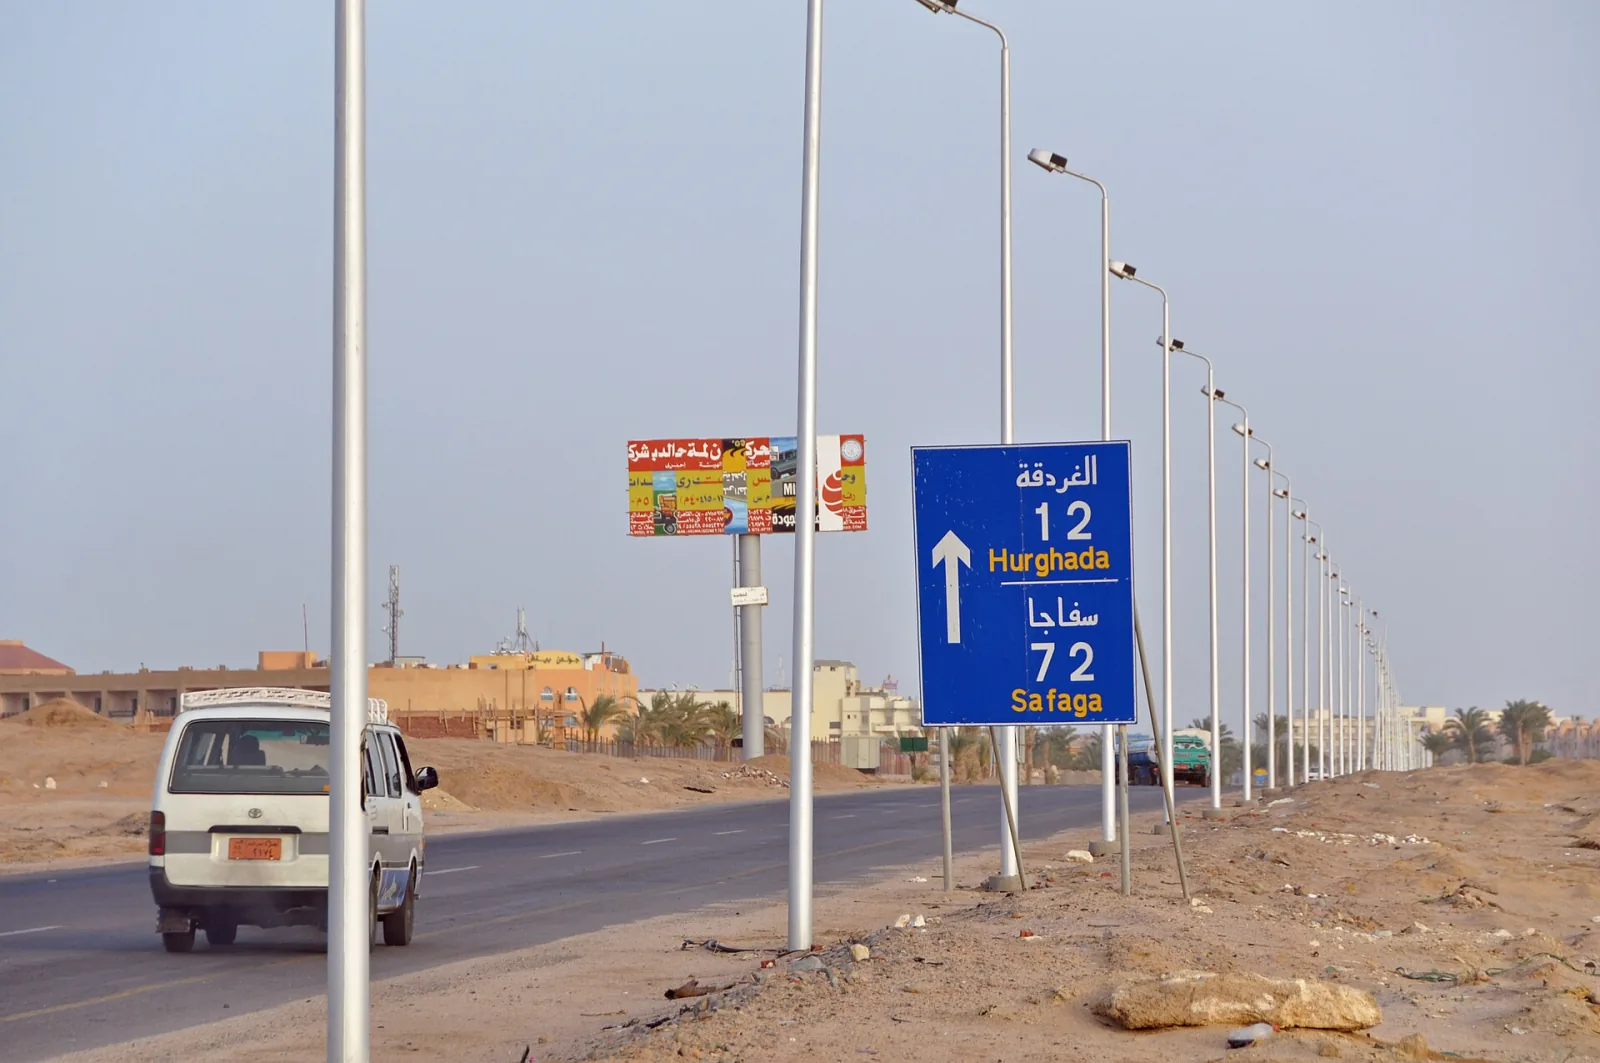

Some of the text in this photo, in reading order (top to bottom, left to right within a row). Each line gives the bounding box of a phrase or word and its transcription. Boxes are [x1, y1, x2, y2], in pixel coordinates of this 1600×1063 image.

[1016, 455, 1097, 494] الغردقة
[989, 545, 1110, 577] Hurghada
[1028, 597, 1099, 635] سفاجا
[1011, 688, 1103, 718] Safaga
